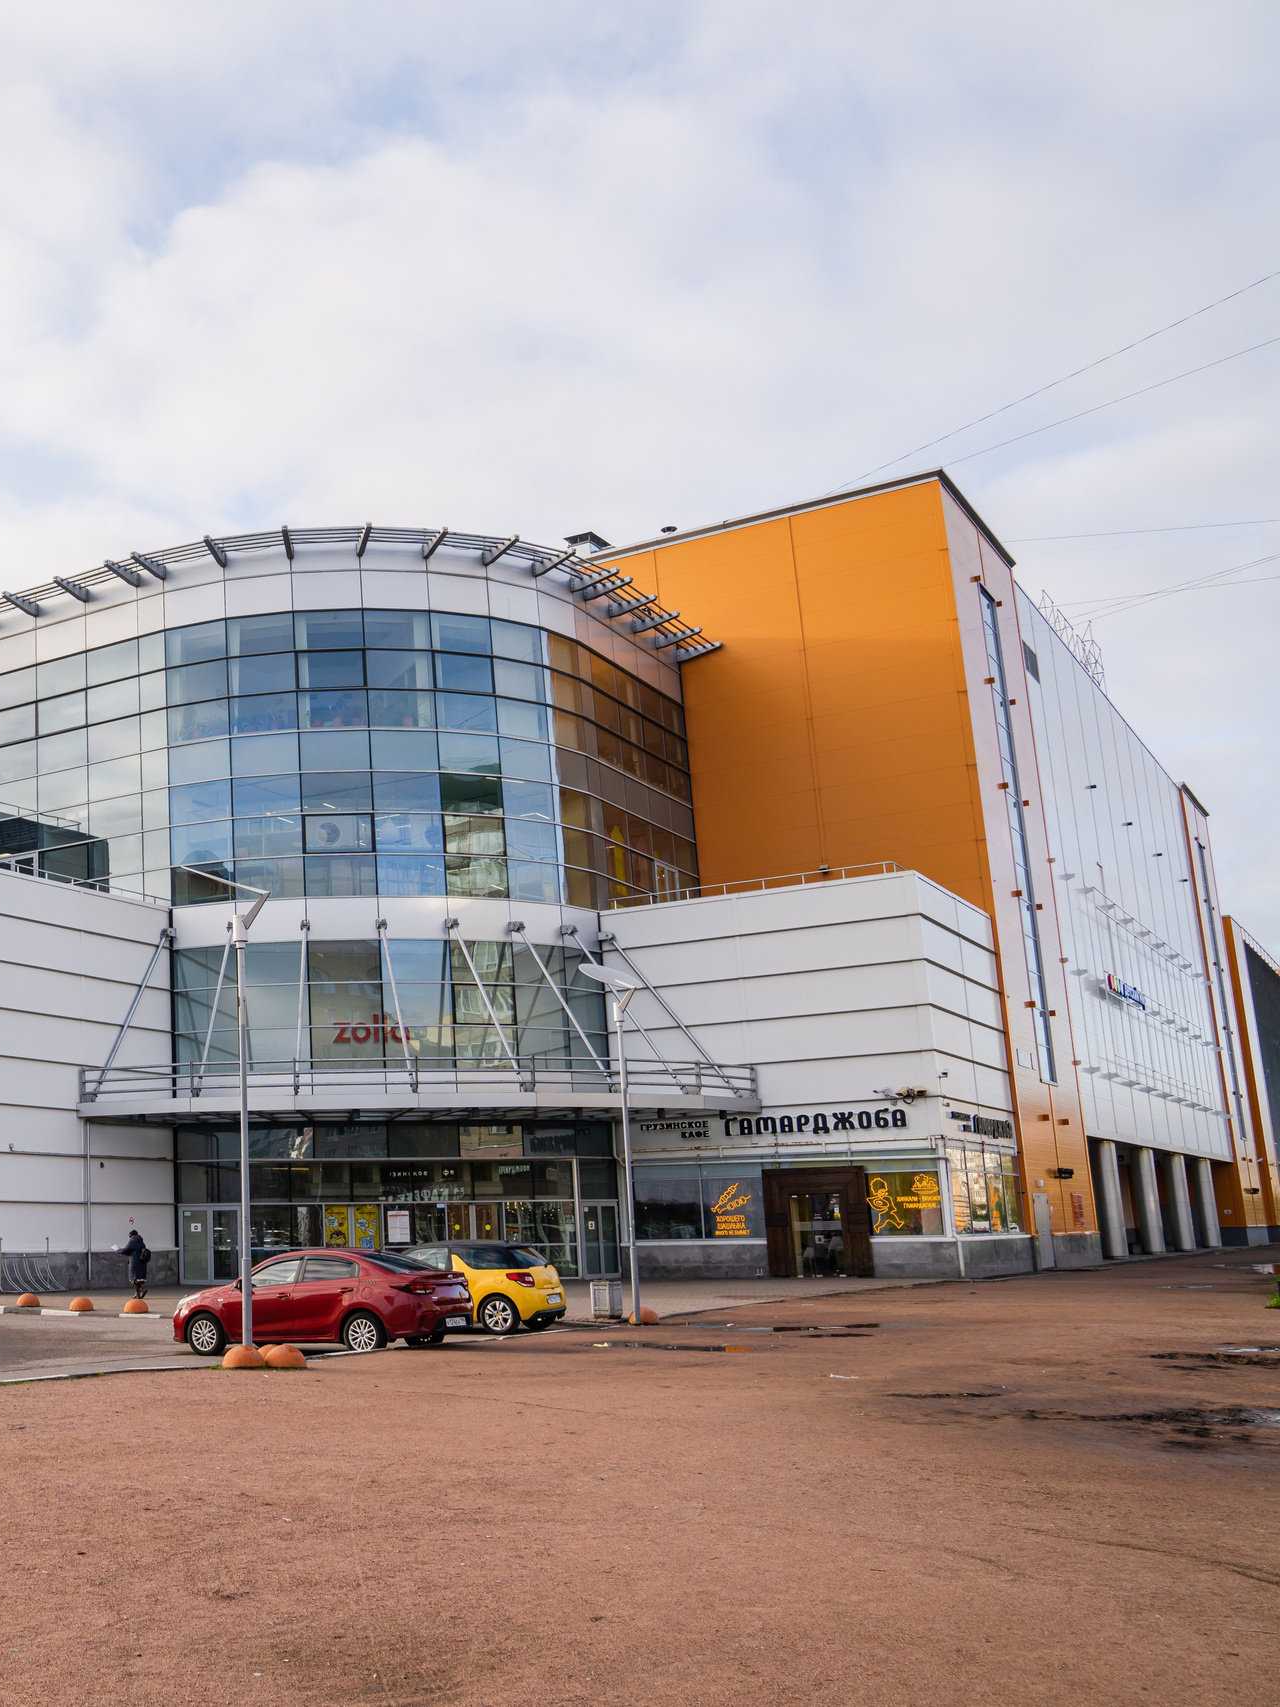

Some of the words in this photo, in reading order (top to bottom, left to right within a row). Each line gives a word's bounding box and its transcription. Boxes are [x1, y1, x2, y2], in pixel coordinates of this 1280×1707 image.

[333, 1013, 410, 1043] zolla
[640, 1120, 709, 1131] ГРУЗИНСКОЕ
[724, 1108, 907, 1136] ГАМАРДЖОБА
[681, 1130, 710, 1139] КАФЕ
